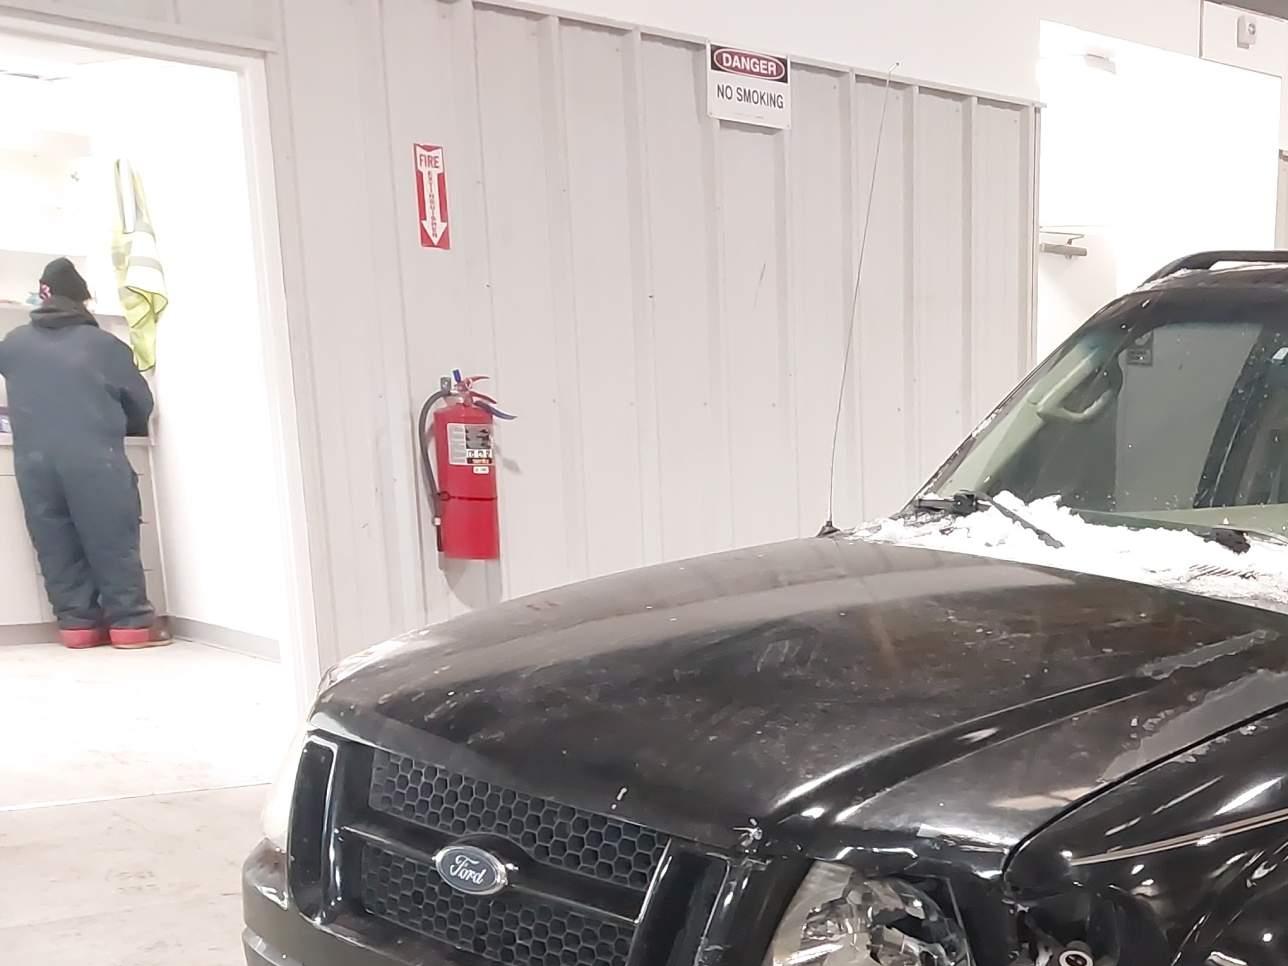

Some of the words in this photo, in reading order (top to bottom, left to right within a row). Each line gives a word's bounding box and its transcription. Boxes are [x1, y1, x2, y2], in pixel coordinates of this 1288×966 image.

[721, 52, 778, 77] DANGER
[716, 83, 733, 101] NO
[735, 86, 785, 109] SMOKING
[418, 153, 440, 169] FIRE
[449, 854, 487, 885] Ford
